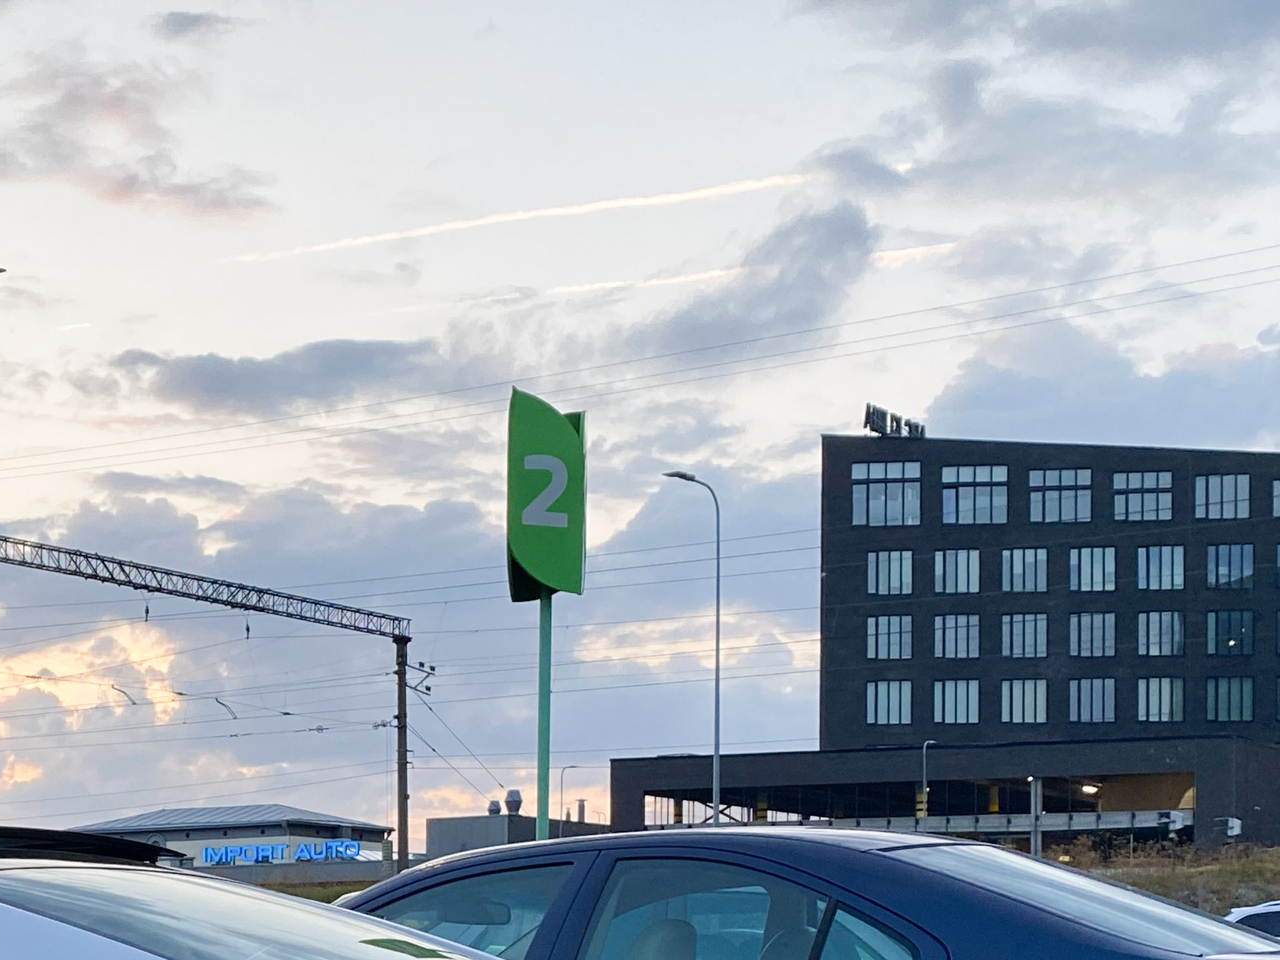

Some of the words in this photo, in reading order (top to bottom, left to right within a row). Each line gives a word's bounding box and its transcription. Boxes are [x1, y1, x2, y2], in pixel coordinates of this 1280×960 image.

[522, 454, 568, 528] 2
[202, 843, 287, 863] IMPORT
[294, 840, 360, 861] AUTO
